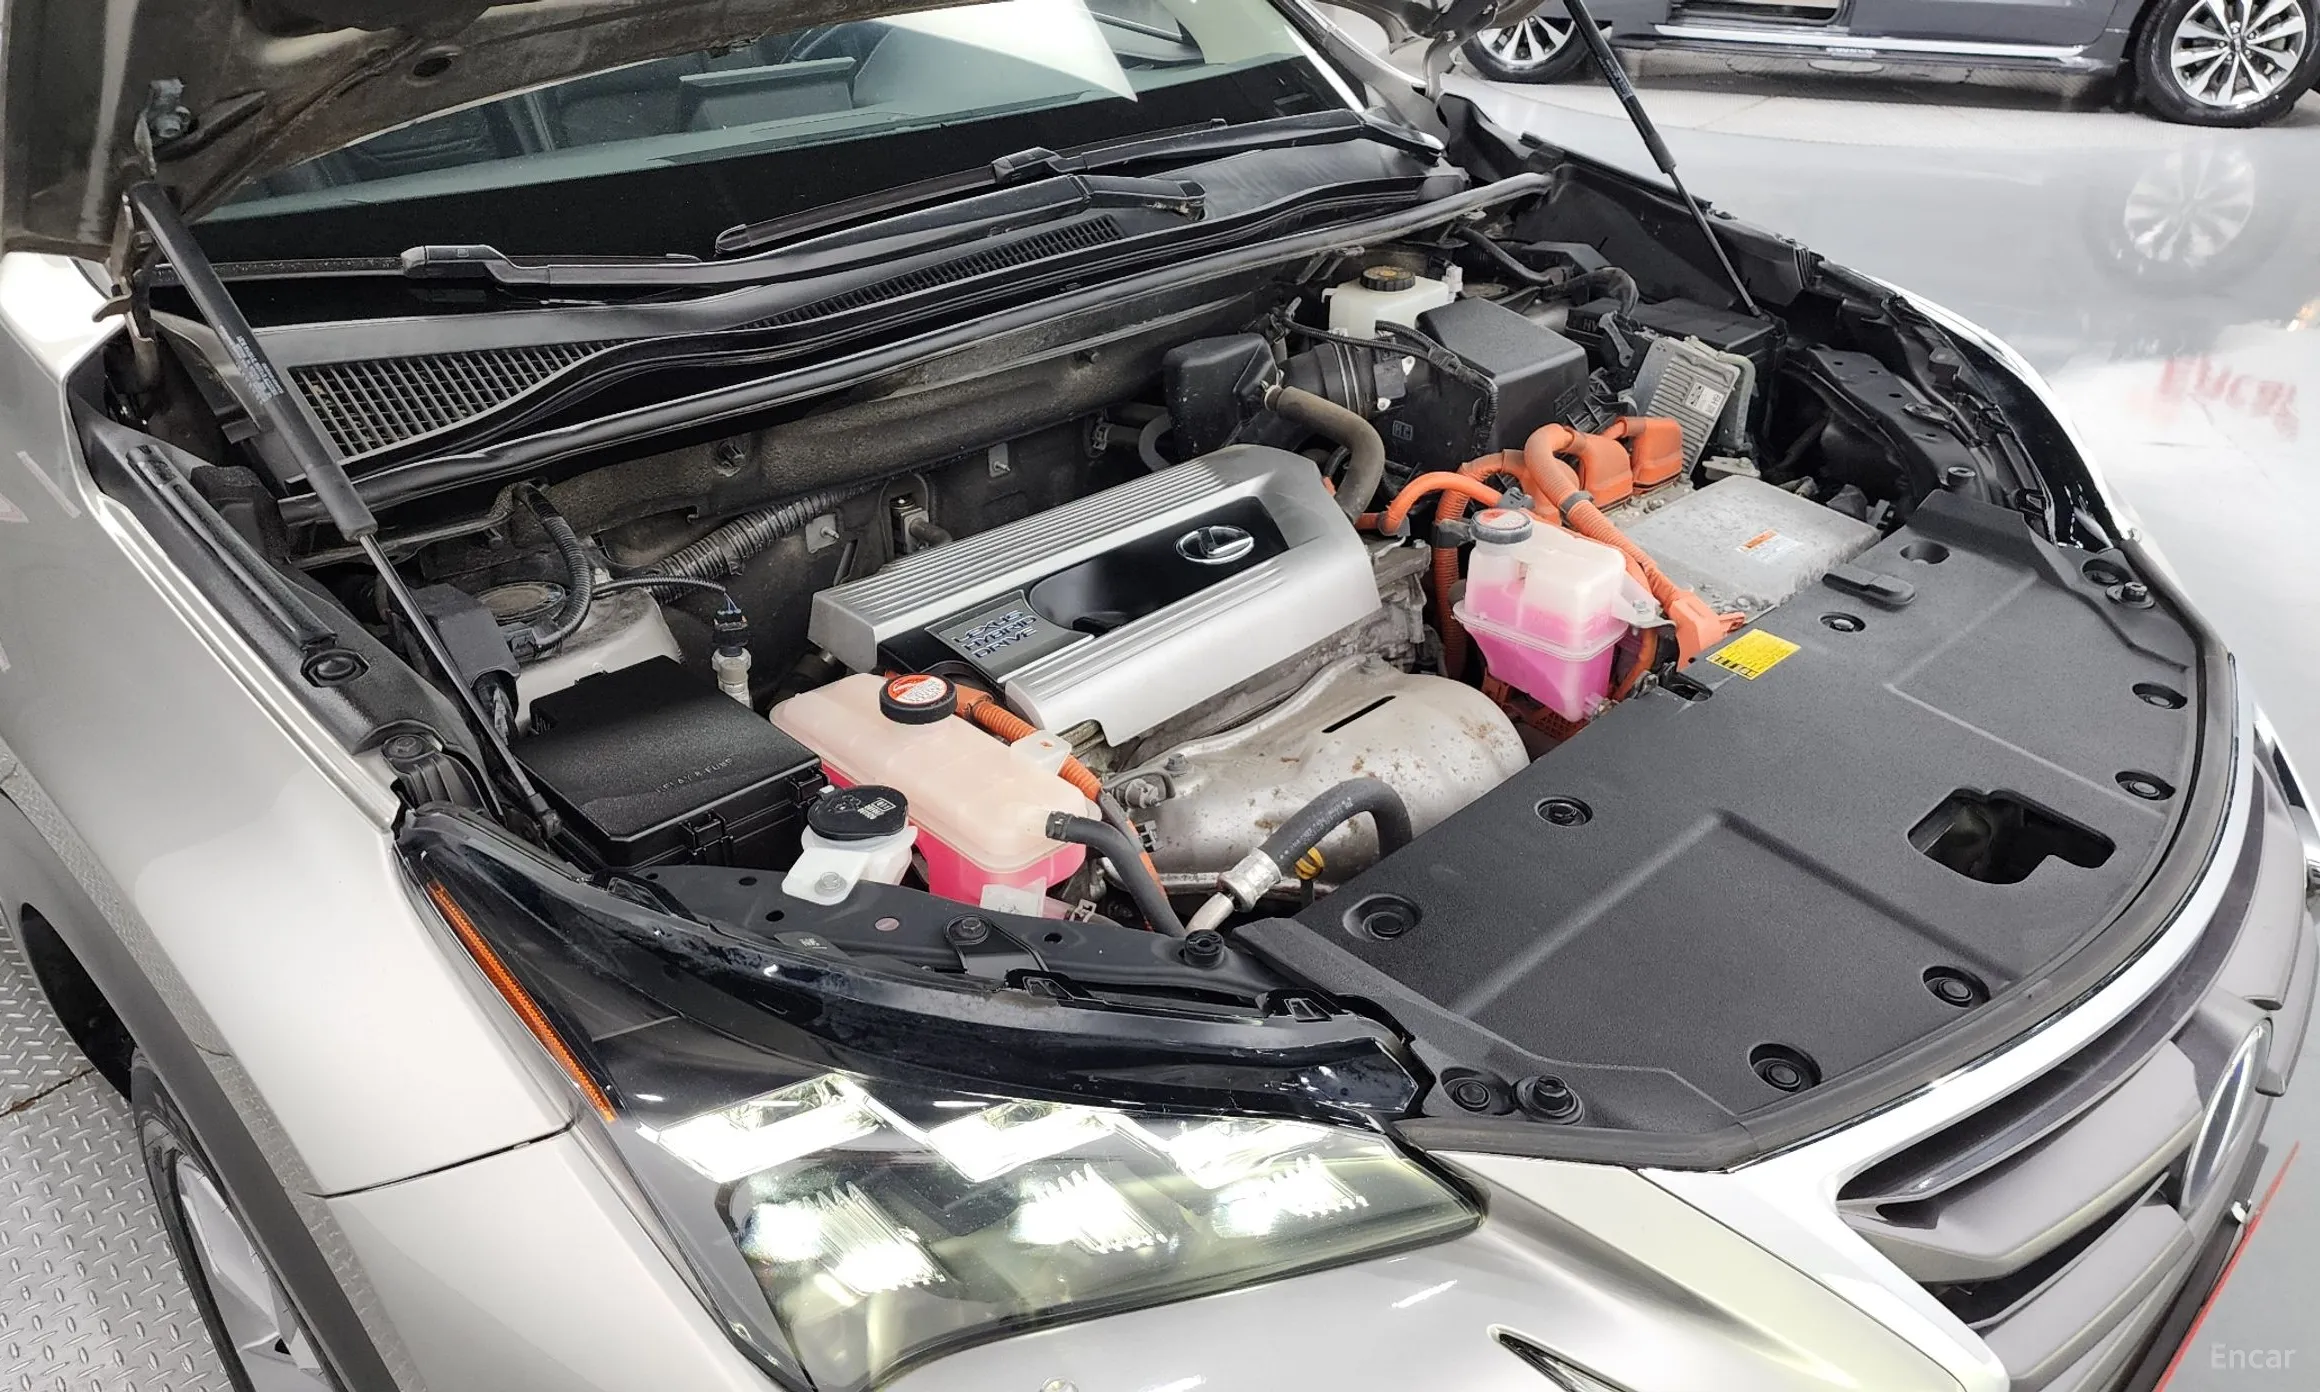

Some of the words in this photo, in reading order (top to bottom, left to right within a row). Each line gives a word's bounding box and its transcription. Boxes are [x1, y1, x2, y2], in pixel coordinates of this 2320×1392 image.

[951, 610, 1023, 643] LEXUS
[961, 615, 1036, 651] HYBRID
[972, 626, 1037, 658] DRIVE
